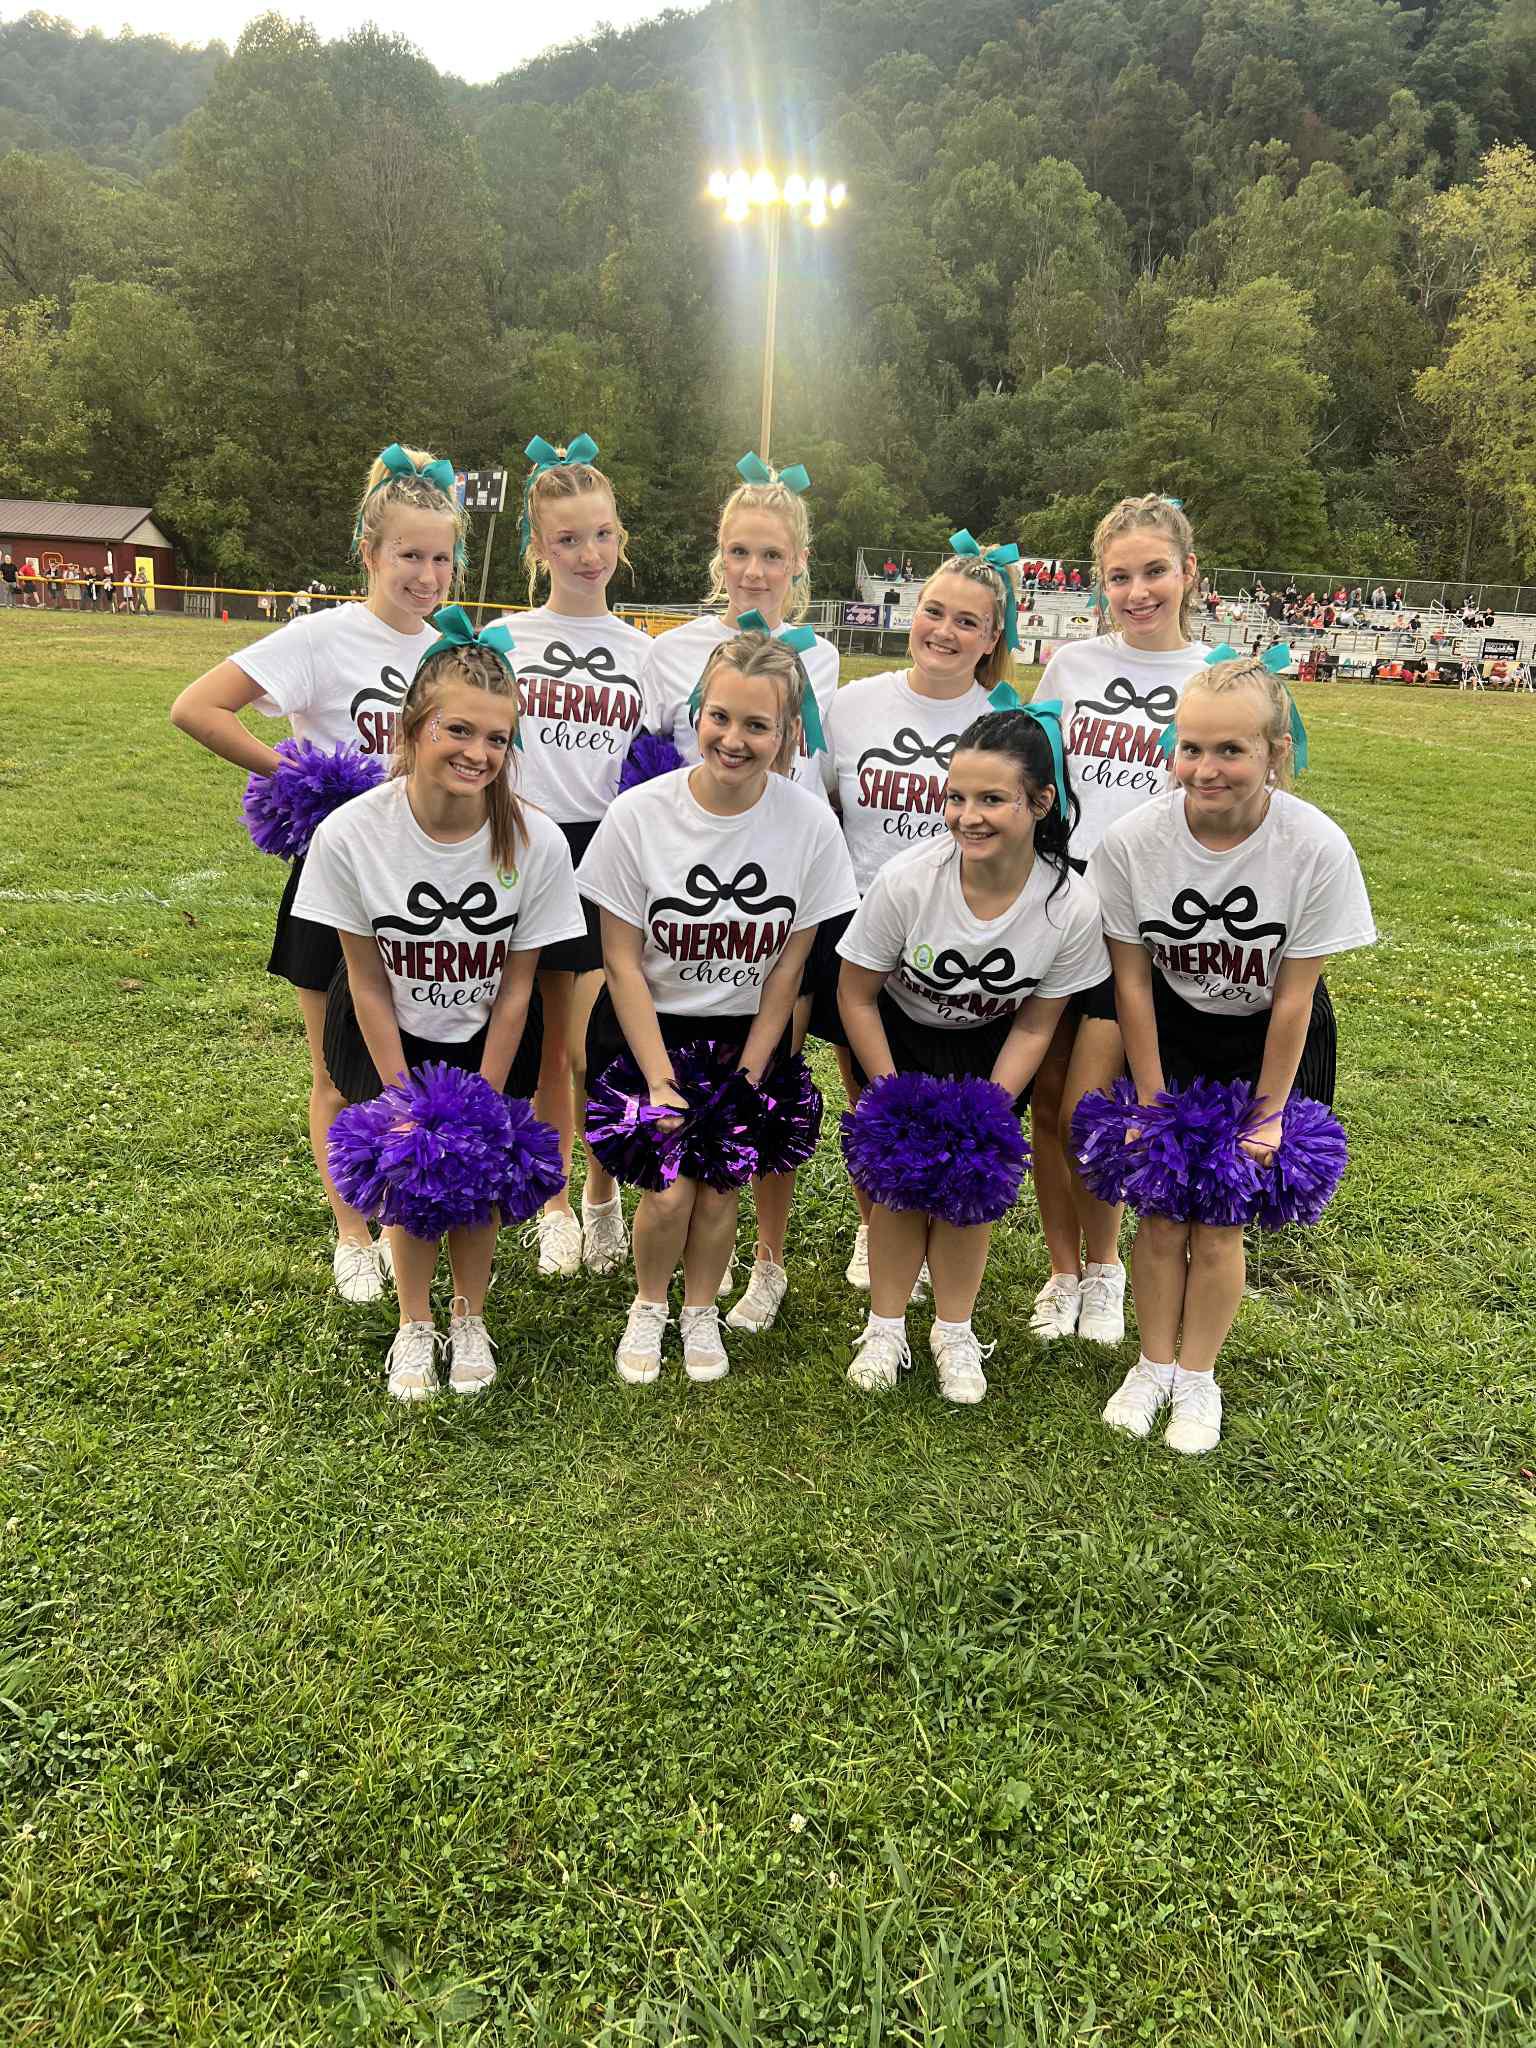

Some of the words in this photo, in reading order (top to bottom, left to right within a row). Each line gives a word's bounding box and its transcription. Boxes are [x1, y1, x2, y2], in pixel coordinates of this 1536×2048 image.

[516, 677, 642, 732] SHERMAN
[540, 721, 624, 754] cheer
[857, 767, 949, 816] SHERM
[1081, 759, 1164, 794] cheer
[883, 812, 950, 840] chee
[377, 935, 506, 983] SHERMA
[679, 960, 762, 987] cheer
[1156, 939, 1277, 987] HERMA
[411, 982, 496, 1008] cheer
